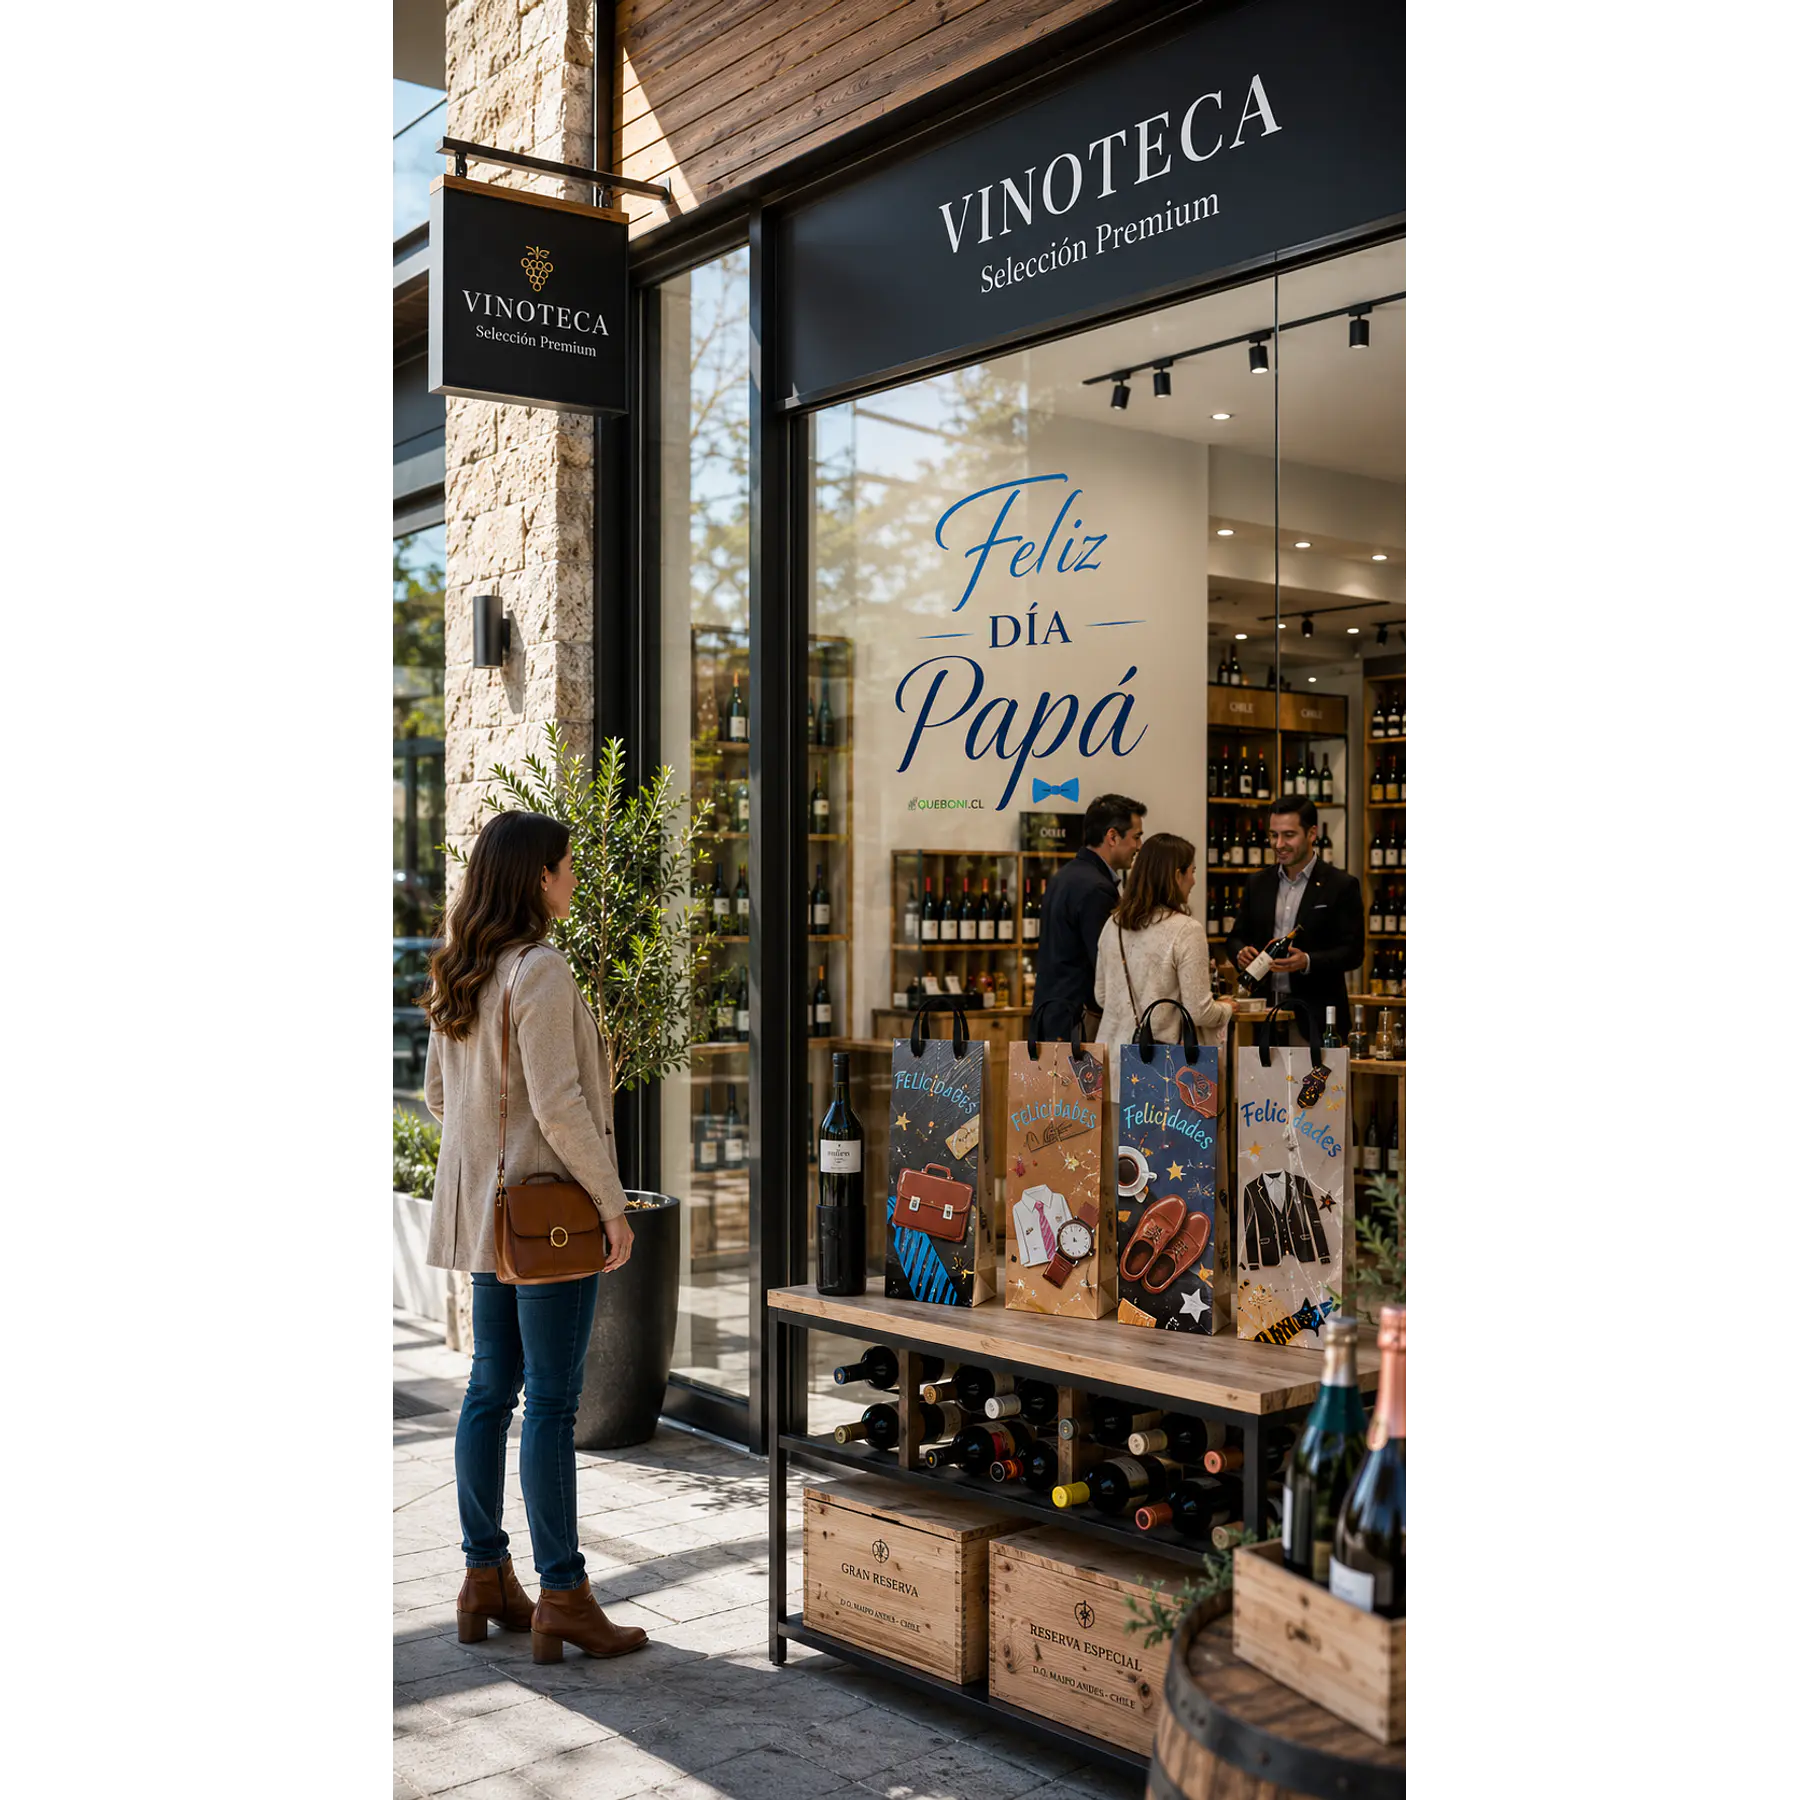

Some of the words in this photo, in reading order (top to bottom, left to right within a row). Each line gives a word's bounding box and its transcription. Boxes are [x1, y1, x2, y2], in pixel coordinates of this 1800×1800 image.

[938, 73, 1283, 254] VINOTECA
[980, 237, 1088, 294] Selección
[1095, 192, 1220, 256] Premium
[461, 289, 610, 336] VINOTECA
[475, 324, 537, 347] Selección
[540, 335, 597, 357] Premium
[935, 473, 1108, 613] Feliz
[988, 602, 1073, 649] DÍA
[895, 655, 1149, 812] Papá
[917, 799, 985, 810] QUEBONI.CL
[1123, 1101, 1214, 1150] Felicidades
[841, 1562, 870, 1581] GRAN
[872, 1573, 919, 1598] RESERVA
[1029, 1623, 1081, 1651] RESERVA
[1083, 1642, 1143, 1672] ESPECIAL
